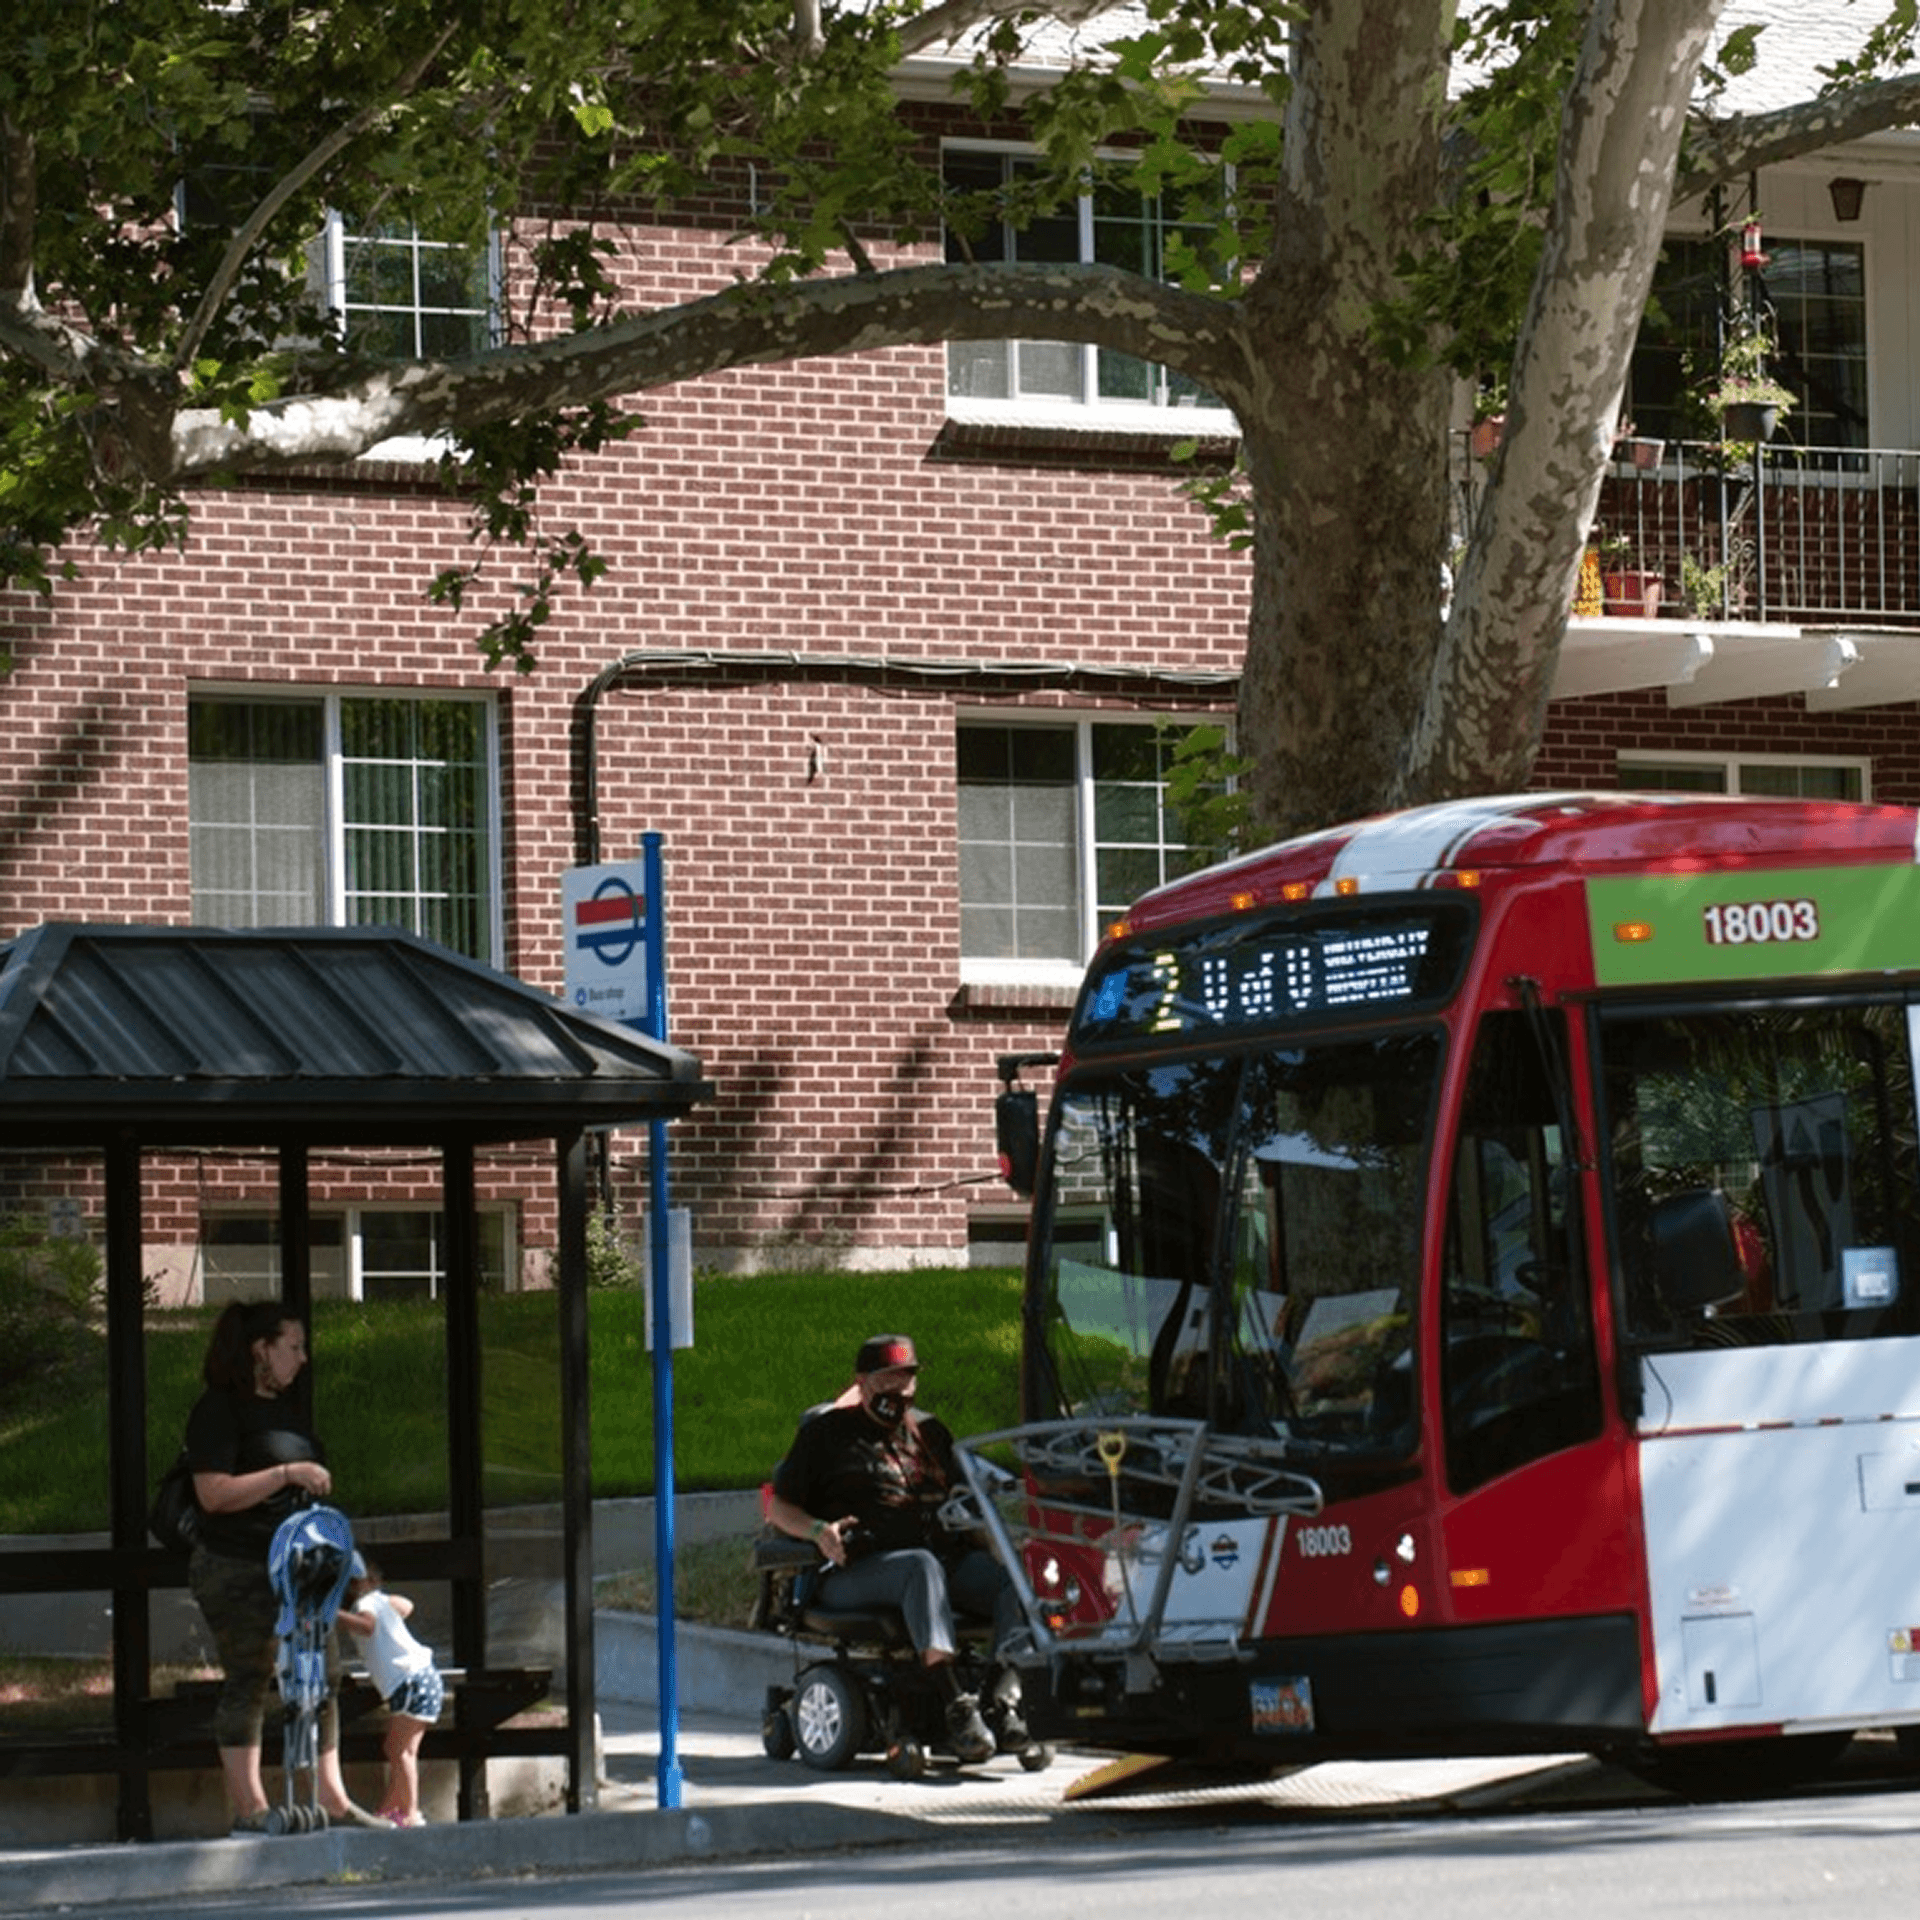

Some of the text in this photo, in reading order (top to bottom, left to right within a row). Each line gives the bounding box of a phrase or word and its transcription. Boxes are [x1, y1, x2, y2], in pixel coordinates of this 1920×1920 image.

[1704, 899, 1818, 945] 18003
[1152, 953, 1182, 1032] 2
[1295, 1523, 1353, 1559] 18003
